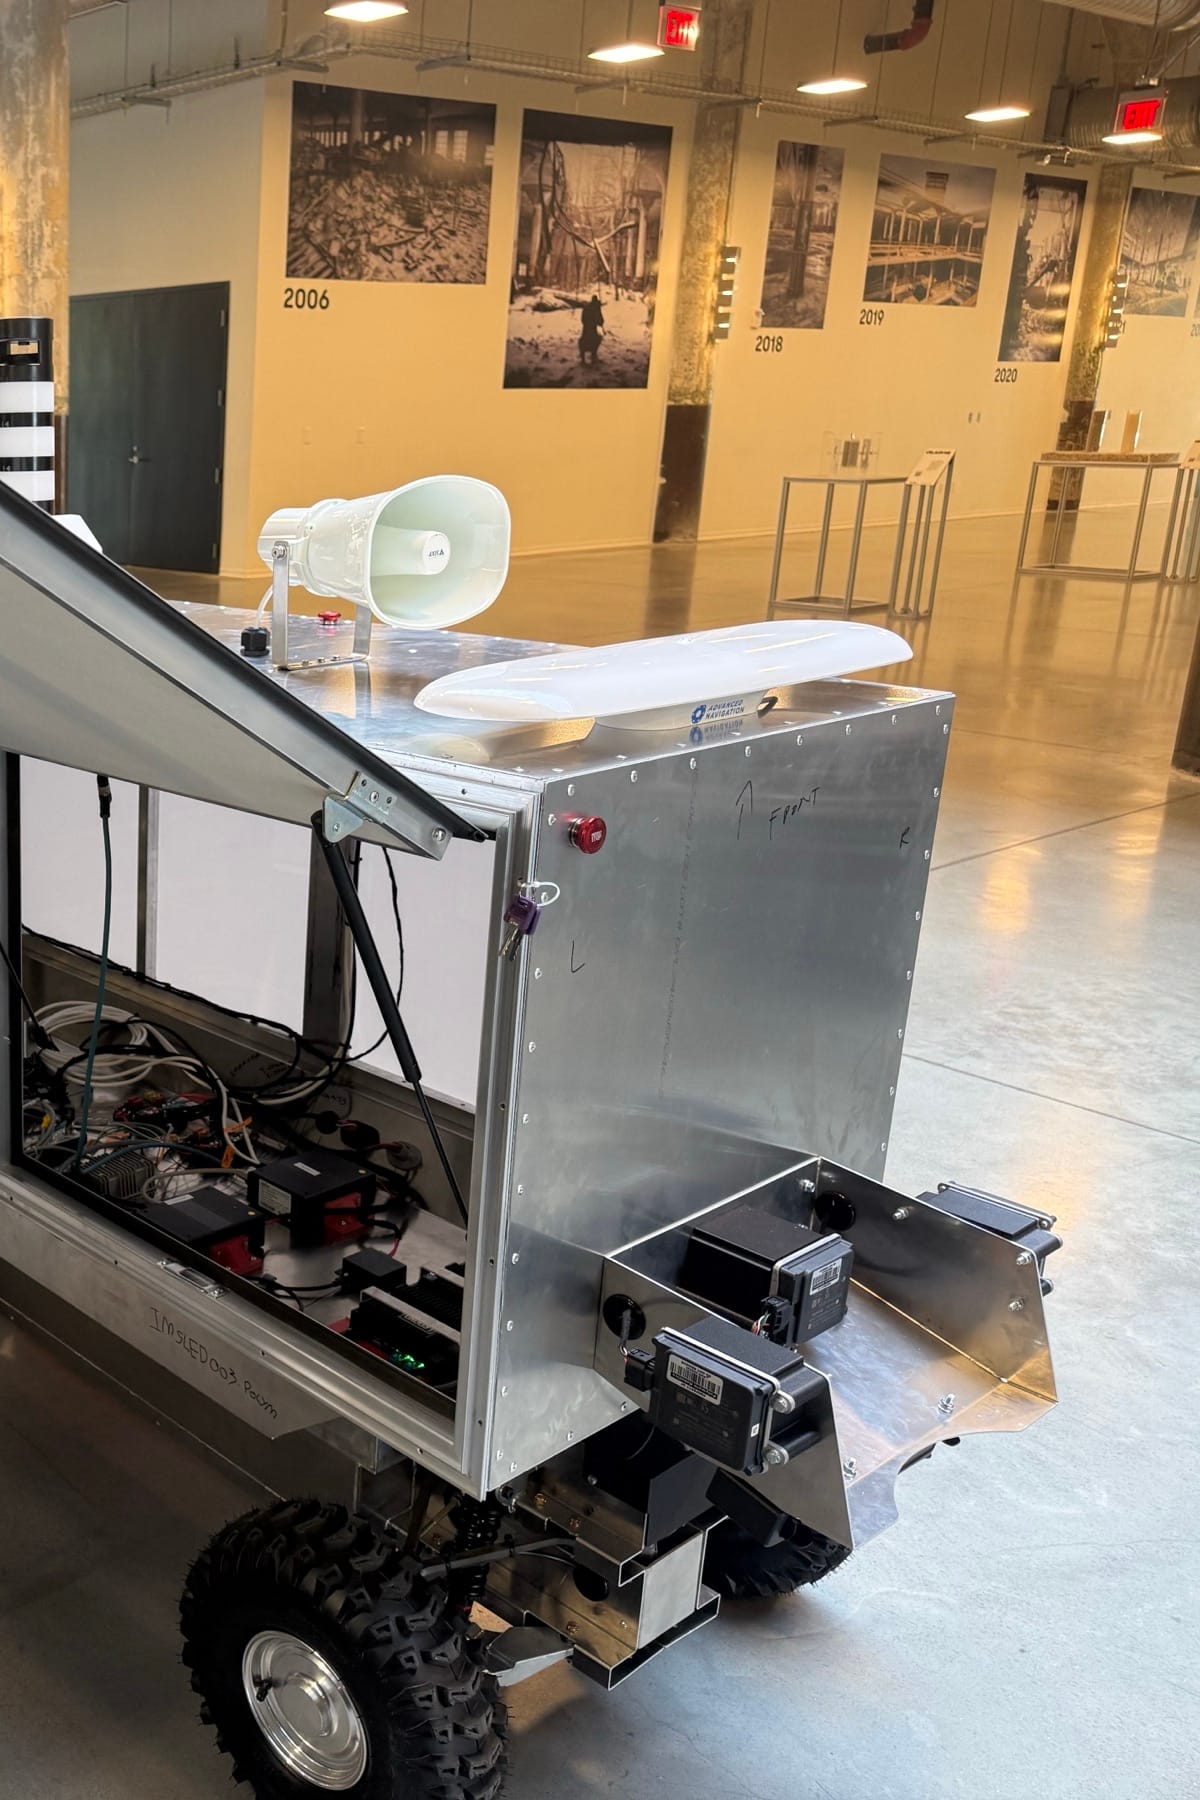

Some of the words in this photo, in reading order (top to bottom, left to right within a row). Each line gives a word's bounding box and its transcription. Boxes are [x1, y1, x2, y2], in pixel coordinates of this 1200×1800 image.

[1122, 99, 1160, 130] EXIT
[284, 287, 330, 310] 2006
[859, 309, 884, 325] 2019
[755, 335, 783, 352] 2018
[994, 368, 1018, 383] 2020
[708, 699, 744, 711] ADVANCED
[705, 707, 745, 720] NAVIGATION
[570, 939, 586, 973] L
